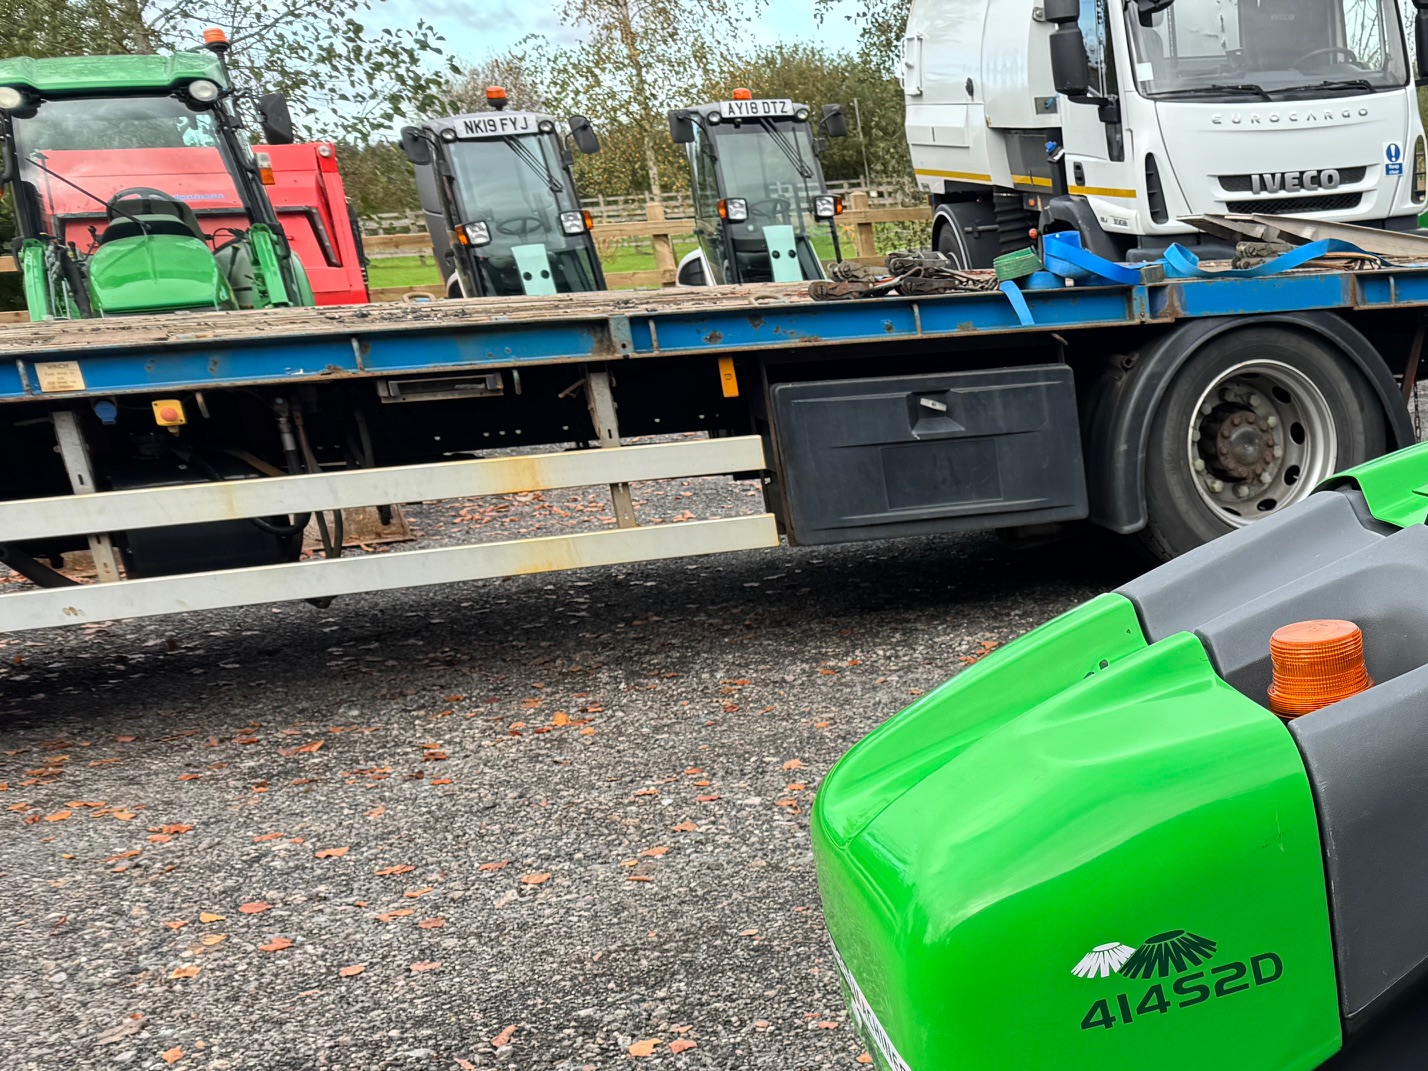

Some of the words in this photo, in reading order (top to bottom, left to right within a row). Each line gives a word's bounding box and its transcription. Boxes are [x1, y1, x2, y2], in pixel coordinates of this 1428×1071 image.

[728, 101, 758, 116] AY18
[761, 101, 788, 114] DTZ
[1211, 107, 1368, 125] EUROCARGO
[463, 118, 497, 134] NK19
[499, 116, 529, 132] FYJ
[1250, 168, 1341, 195] IVECO
[1080, 951, 1284, 1030] 414S2D
